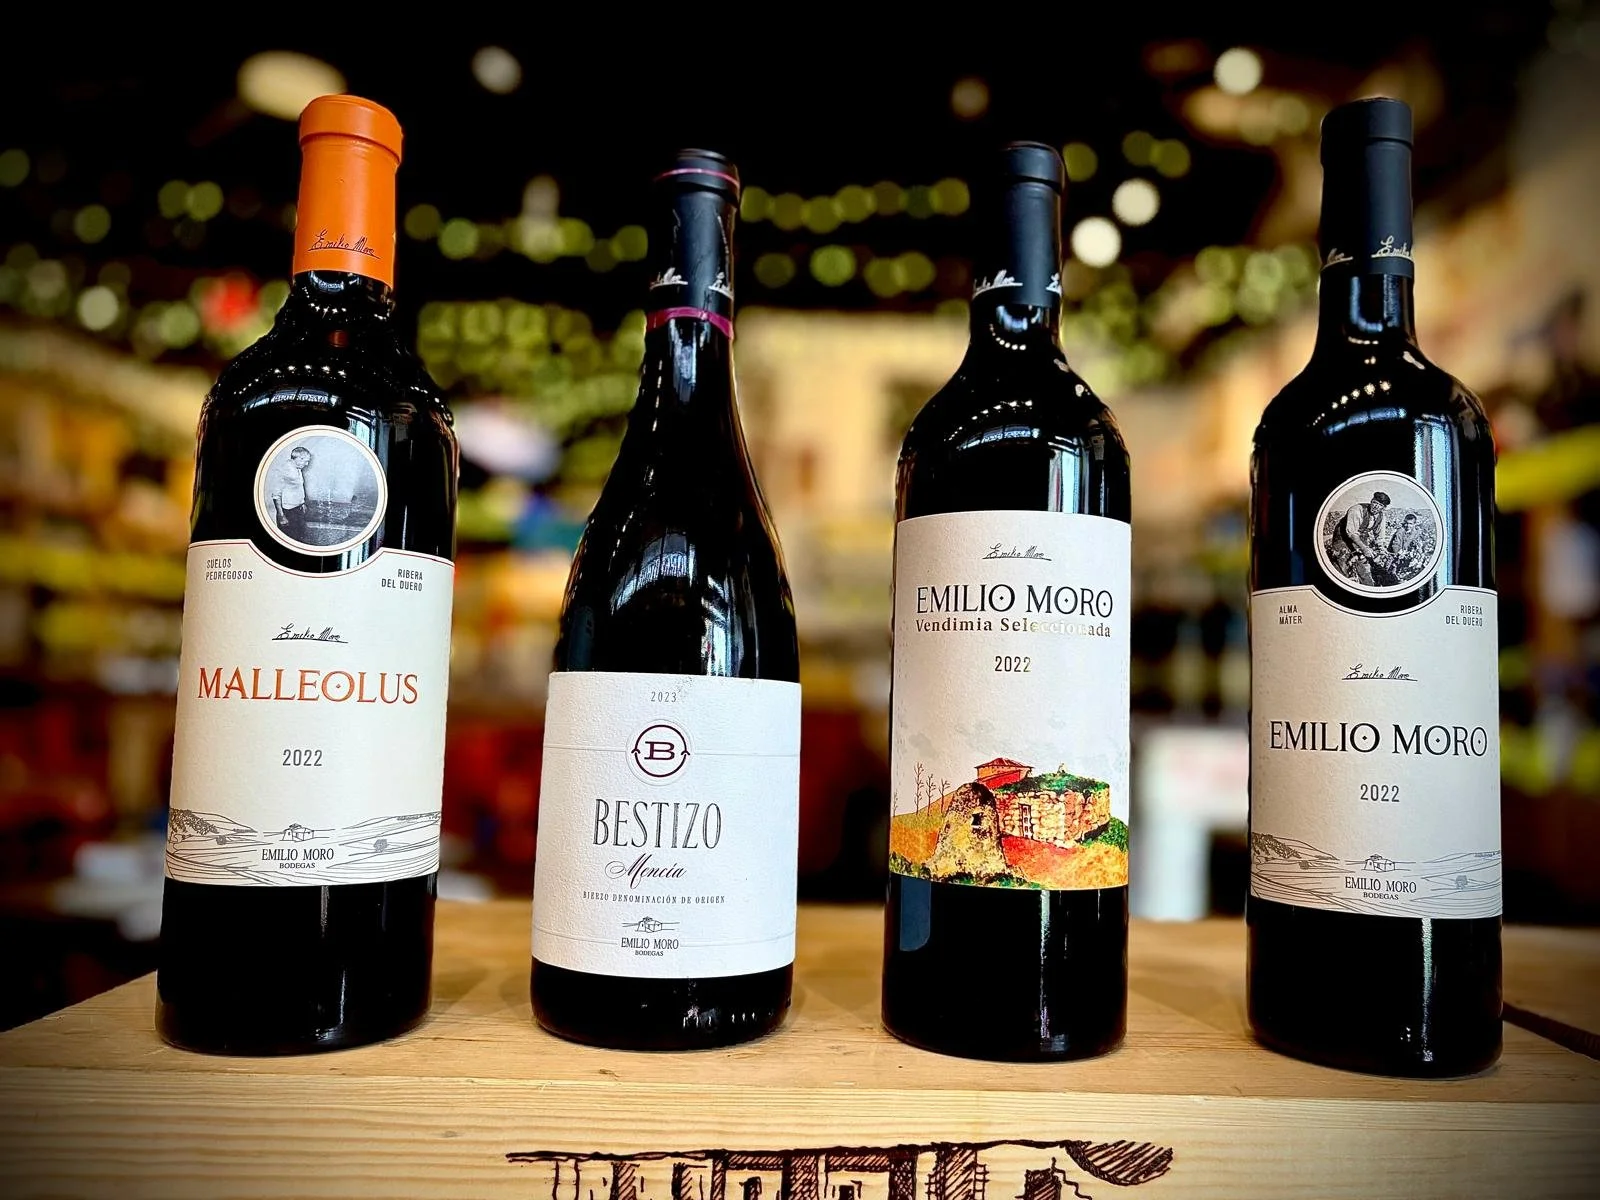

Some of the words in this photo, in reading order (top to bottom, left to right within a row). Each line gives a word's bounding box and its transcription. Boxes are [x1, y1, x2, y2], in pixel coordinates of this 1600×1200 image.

[206, 558, 232, 569] SUELOS
[205, 570, 253, 581] PEDREGOSOS
[397, 568, 423, 581] RIBERA
[381, 578, 397, 589] DEL
[399, 579, 423, 592] DUERO
[916, 583, 1016, 614] EMILIO
[1025, 584, 1113, 618] MORO
[1279, 605, 1297, 614] ALMA
[1460, 604, 1483, 616] RIBERA
[1279, 615, 1303, 625] MÁTER
[1445, 615, 1460, 625] DEL
[1462, 616, 1483, 627] DUERO
[915, 617, 993, 633] Vendimia
[1000, 617, 1111, 638] Seleccionada
[994, 655, 1031, 673] 2022
[197, 666, 418, 705] MALLEOLUS
[650, 691, 678, 703] 2023
[1269, 720, 1381, 753] EMILIO
[1392, 723, 1488, 757] MORO
[644, 740, 676, 761] B
[282, 749, 323, 767] 2022
[1360, 783, 1400, 803] 2022
[592, 798, 722, 850] BESTIZO
[261, 847, 298, 861] EMILIO
[303, 847, 334, 861] MORO
[279, 862, 316, 870] BODEGAS
[604, 852, 687, 890] Mencía
[1345, 876, 1381, 892] EMILIO
[1386, 879, 1417, 894] MORO
[582, 891, 609, 901] BIERZO
[612, 893, 678, 904] DENOMINACIÓN
[681, 895, 692, 904] DE
[695, 895, 726, 904] ORIGEN
[1363, 892, 1399, 901] BODEGAS
[620, 937, 650, 949] EMILIO
[653, 938, 680, 950] MORO
[634, 949, 664, 957] BODEGAS
